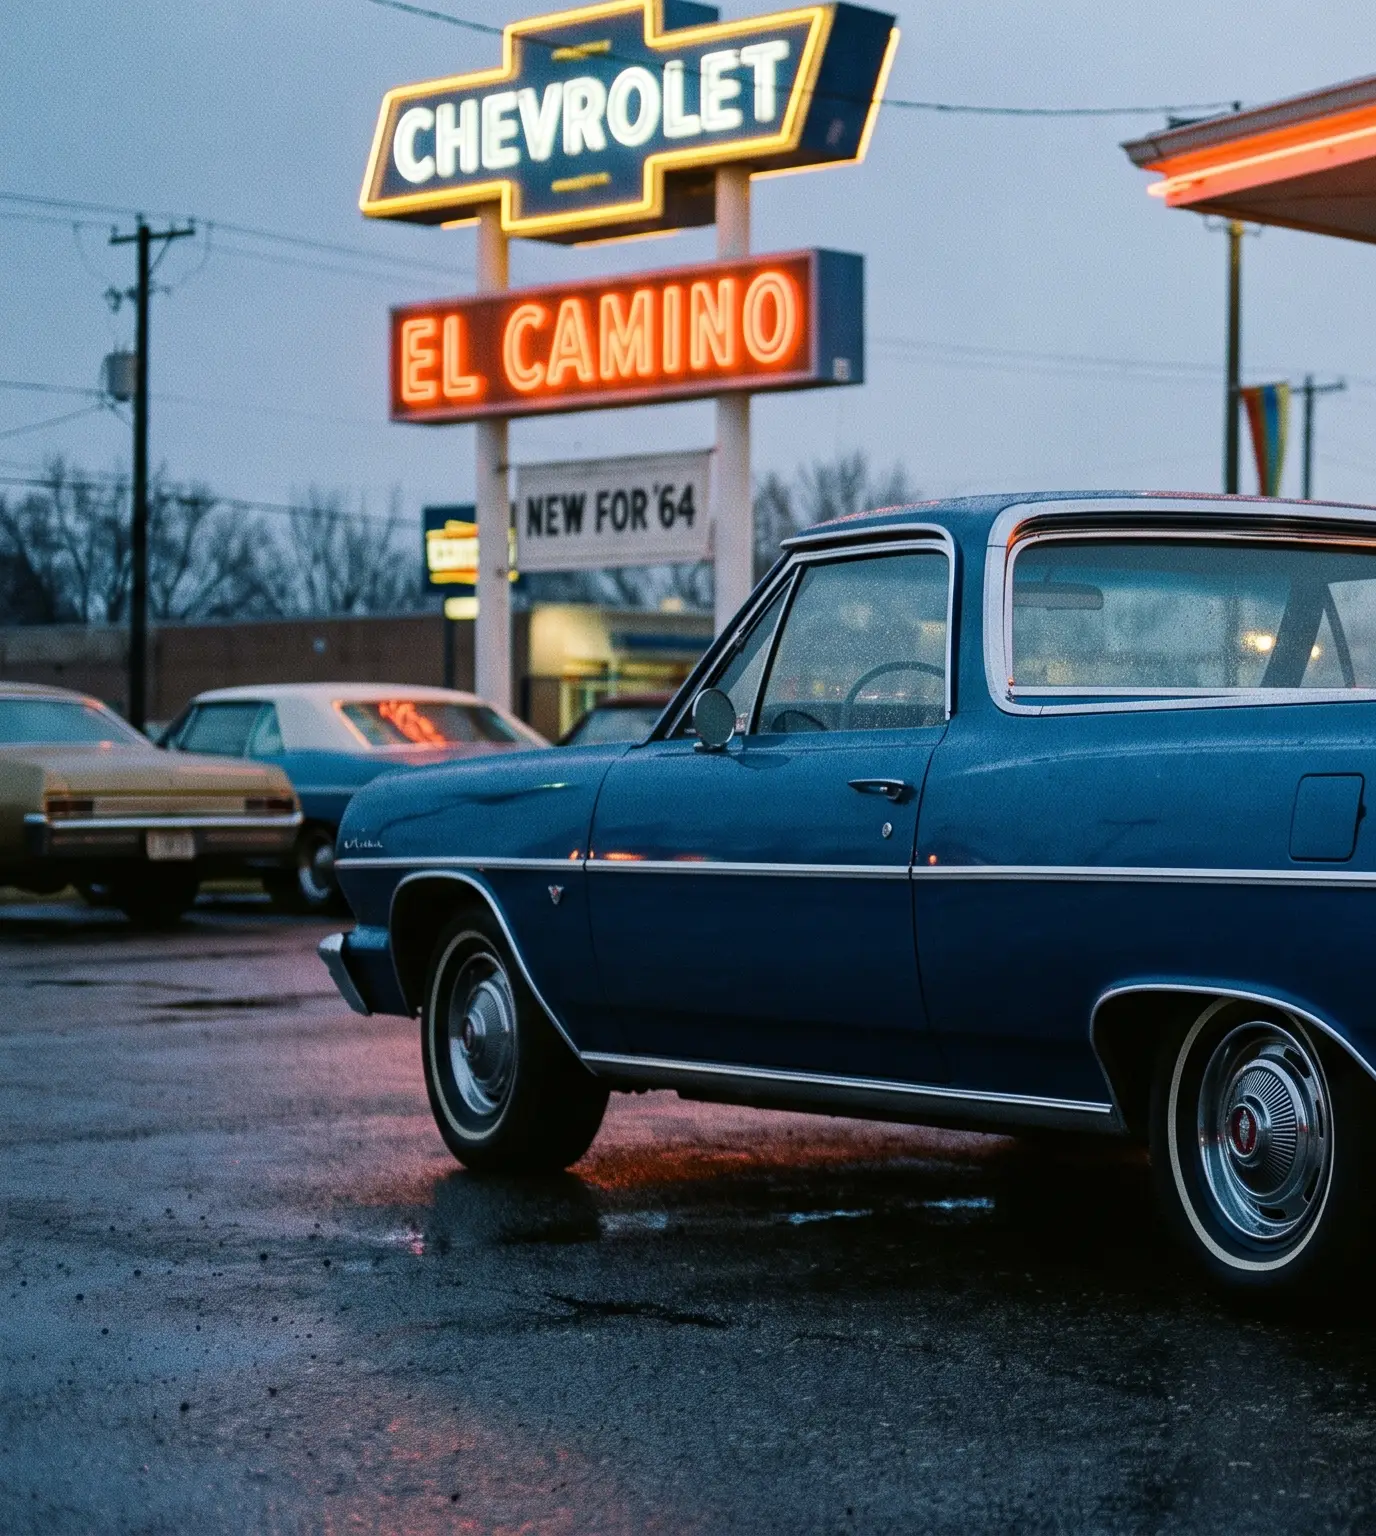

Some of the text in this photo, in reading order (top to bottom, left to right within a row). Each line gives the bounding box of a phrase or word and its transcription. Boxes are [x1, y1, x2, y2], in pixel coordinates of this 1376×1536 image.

[392, 40, 790, 184] CHEVROLET
[401, 271, 796, 402] EL CAMINO
[526, 482, 695, 537] NEW FOR '64
